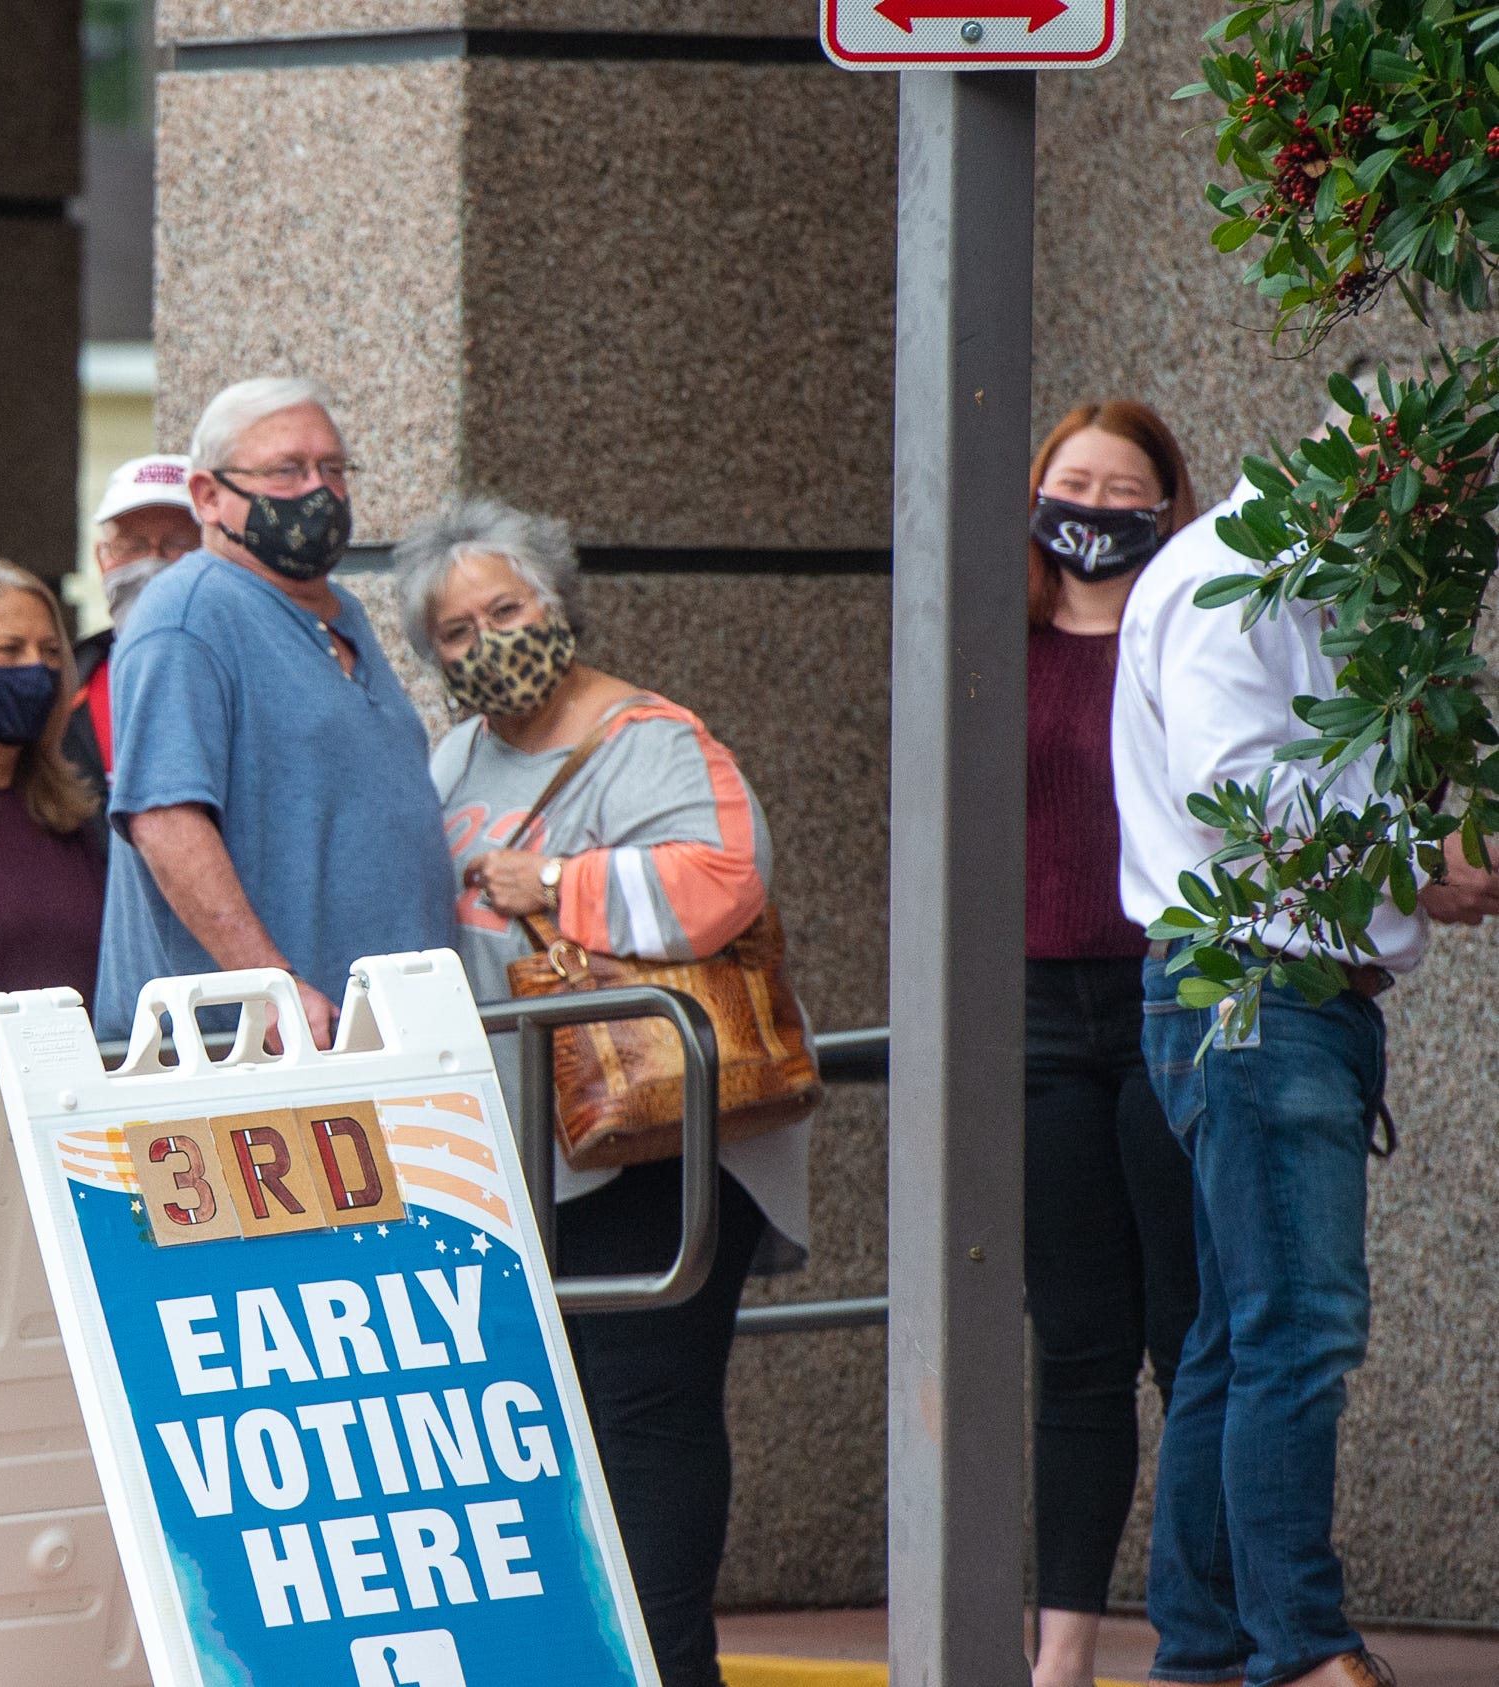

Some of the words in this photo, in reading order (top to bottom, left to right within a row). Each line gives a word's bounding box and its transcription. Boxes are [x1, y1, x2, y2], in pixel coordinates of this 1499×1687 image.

[148, 1116, 383, 1226] 3RD
[156, 1265, 487, 1396] EARLY
[155, 1380, 561, 1518] VOTING
[241, 1499, 544, 1628] HERE
